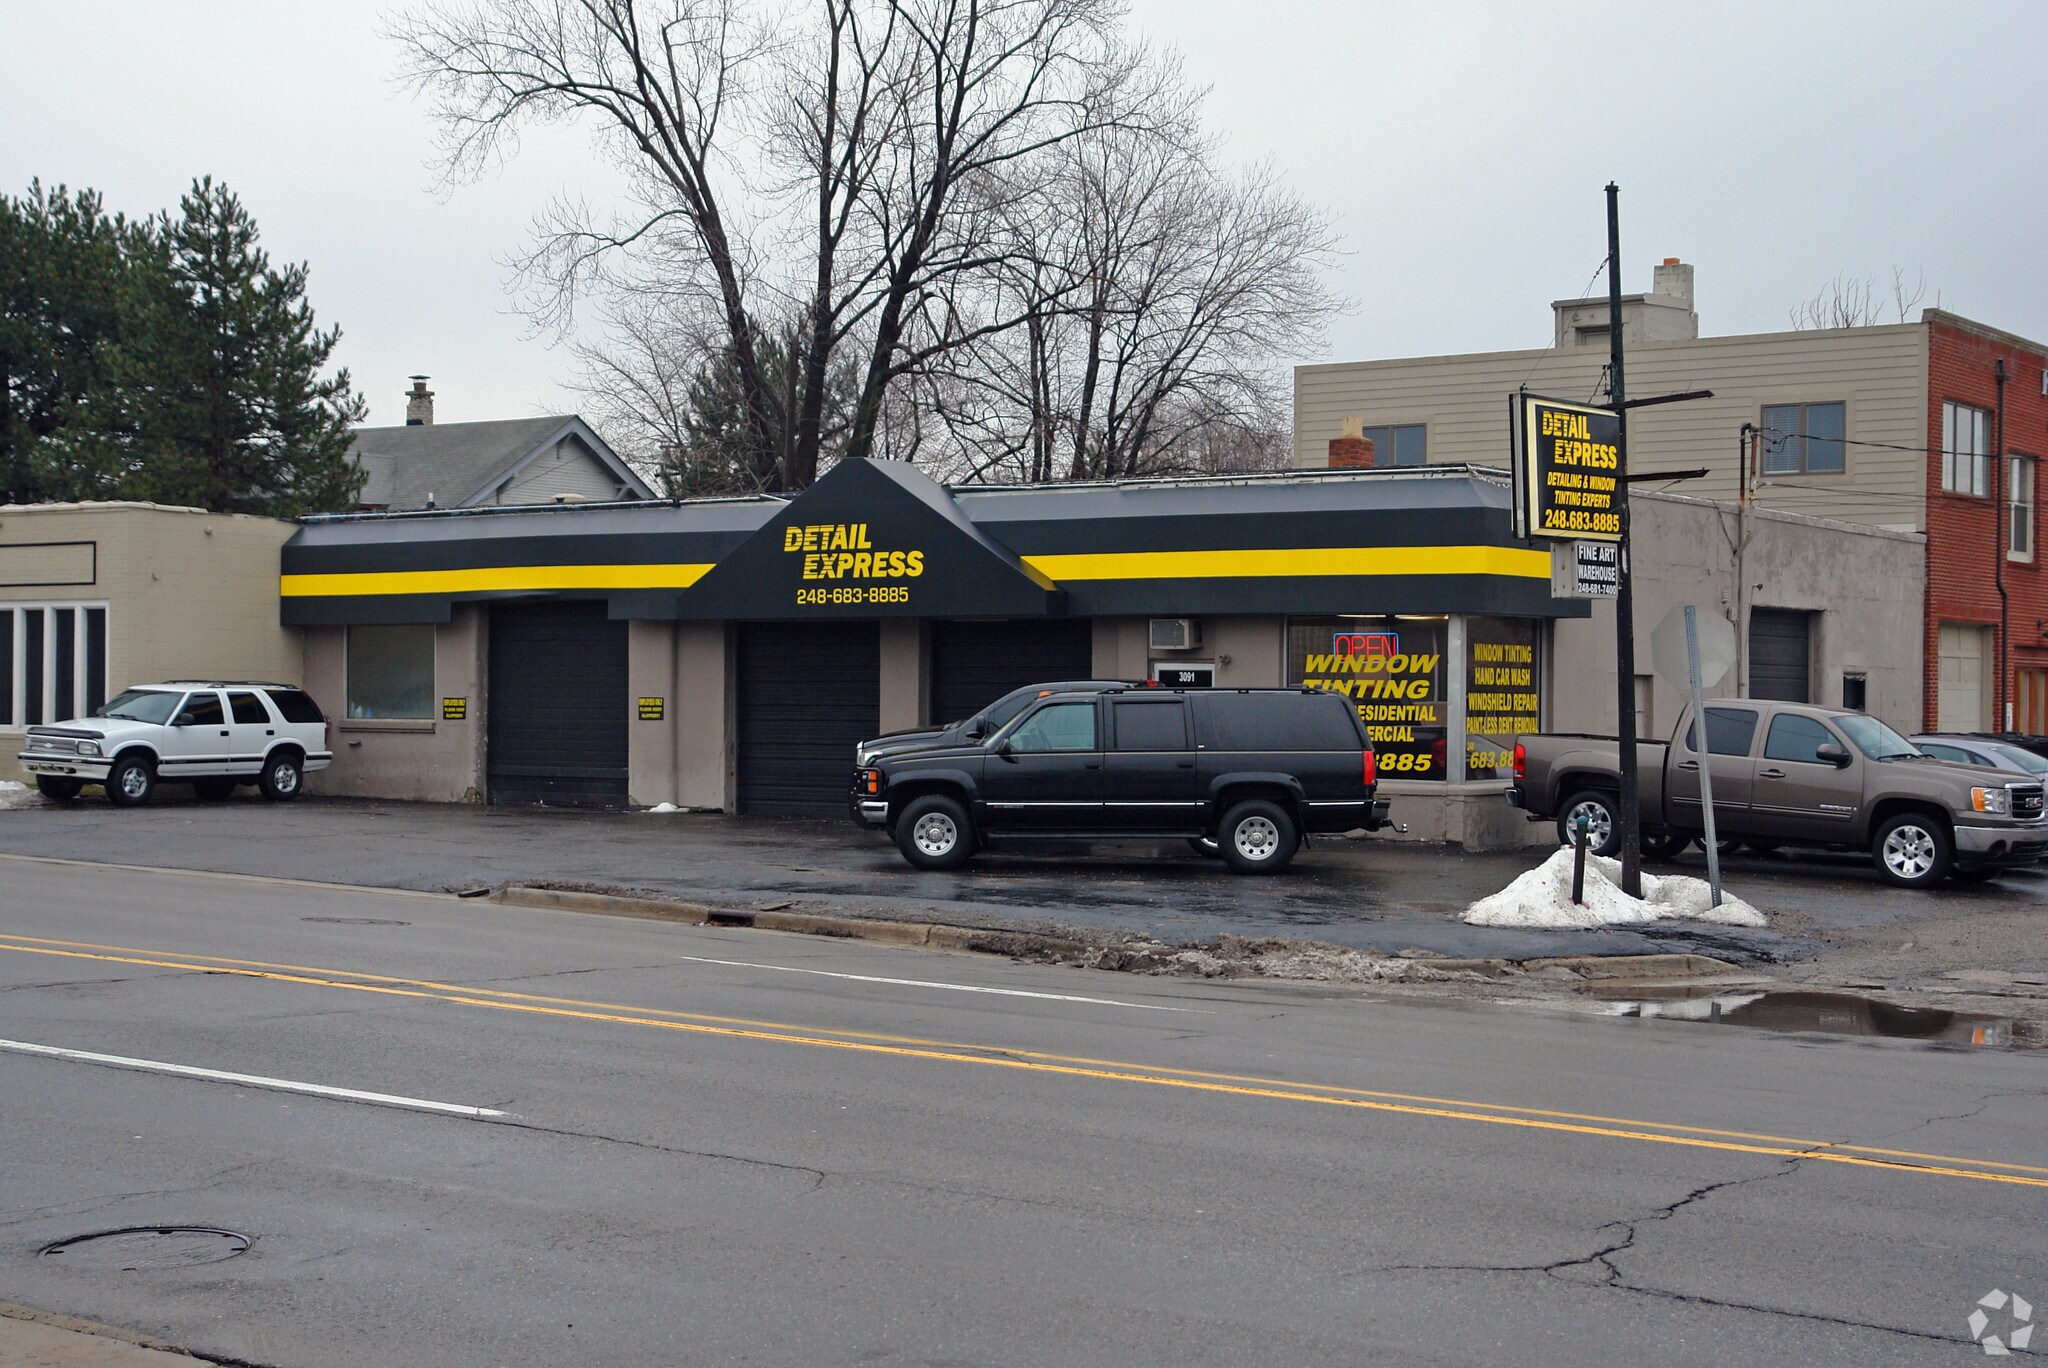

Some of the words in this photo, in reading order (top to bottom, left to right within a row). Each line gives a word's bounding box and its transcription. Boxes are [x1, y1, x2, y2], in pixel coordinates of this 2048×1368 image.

[1543, 411, 1591, 440] DETAIL
[1554, 439, 1618, 470] EXPRESS
[1547, 471, 1582, 489] DETAILING
[1582, 475, 1589, 489] &
[1589, 476, 1616, 492] WINDOW
[1554, 490, 1581, 506] TINTING
[1581, 492, 1611, 509] EXPERTS
[1545, 509, 1620, 532] 248.683.8885
[784, 523, 872, 552] DETAIL
[1578, 545, 1598, 561] FINE
[1598, 547, 1615, 562] ART
[802, 550, 925, 580] EXPRESS
[1578, 564, 1616, 582] WAREHOUSE
[797, 587, 909, 604] 248-683-8885
[1335, 635, 1397, 662] OPEN
[1474, 643, 1504, 662] WINDOW
[1504, 645, 1532, 663] TINTING
[1305, 654, 1440, 674] WINDOW
[1179, 671, 1195, 682] 3091
[1474, 667, 1495, 685] HAND
[1495, 667, 1510, 686] CAR
[1511, 668, 1531, 686] WASH
[1302, 679, 1430, 699] TINTING
[1468, 692, 1512, 711] WINDSHIELD
[1513, 693, 1538, 712] REPAIR
[1354, 705, 1437, 722] ESIDENTIAL
[1498, 716, 1514, 735] DENT
[1514, 716, 1539, 735] REMOVAL
[1376, 753, 1433, 772] 885
